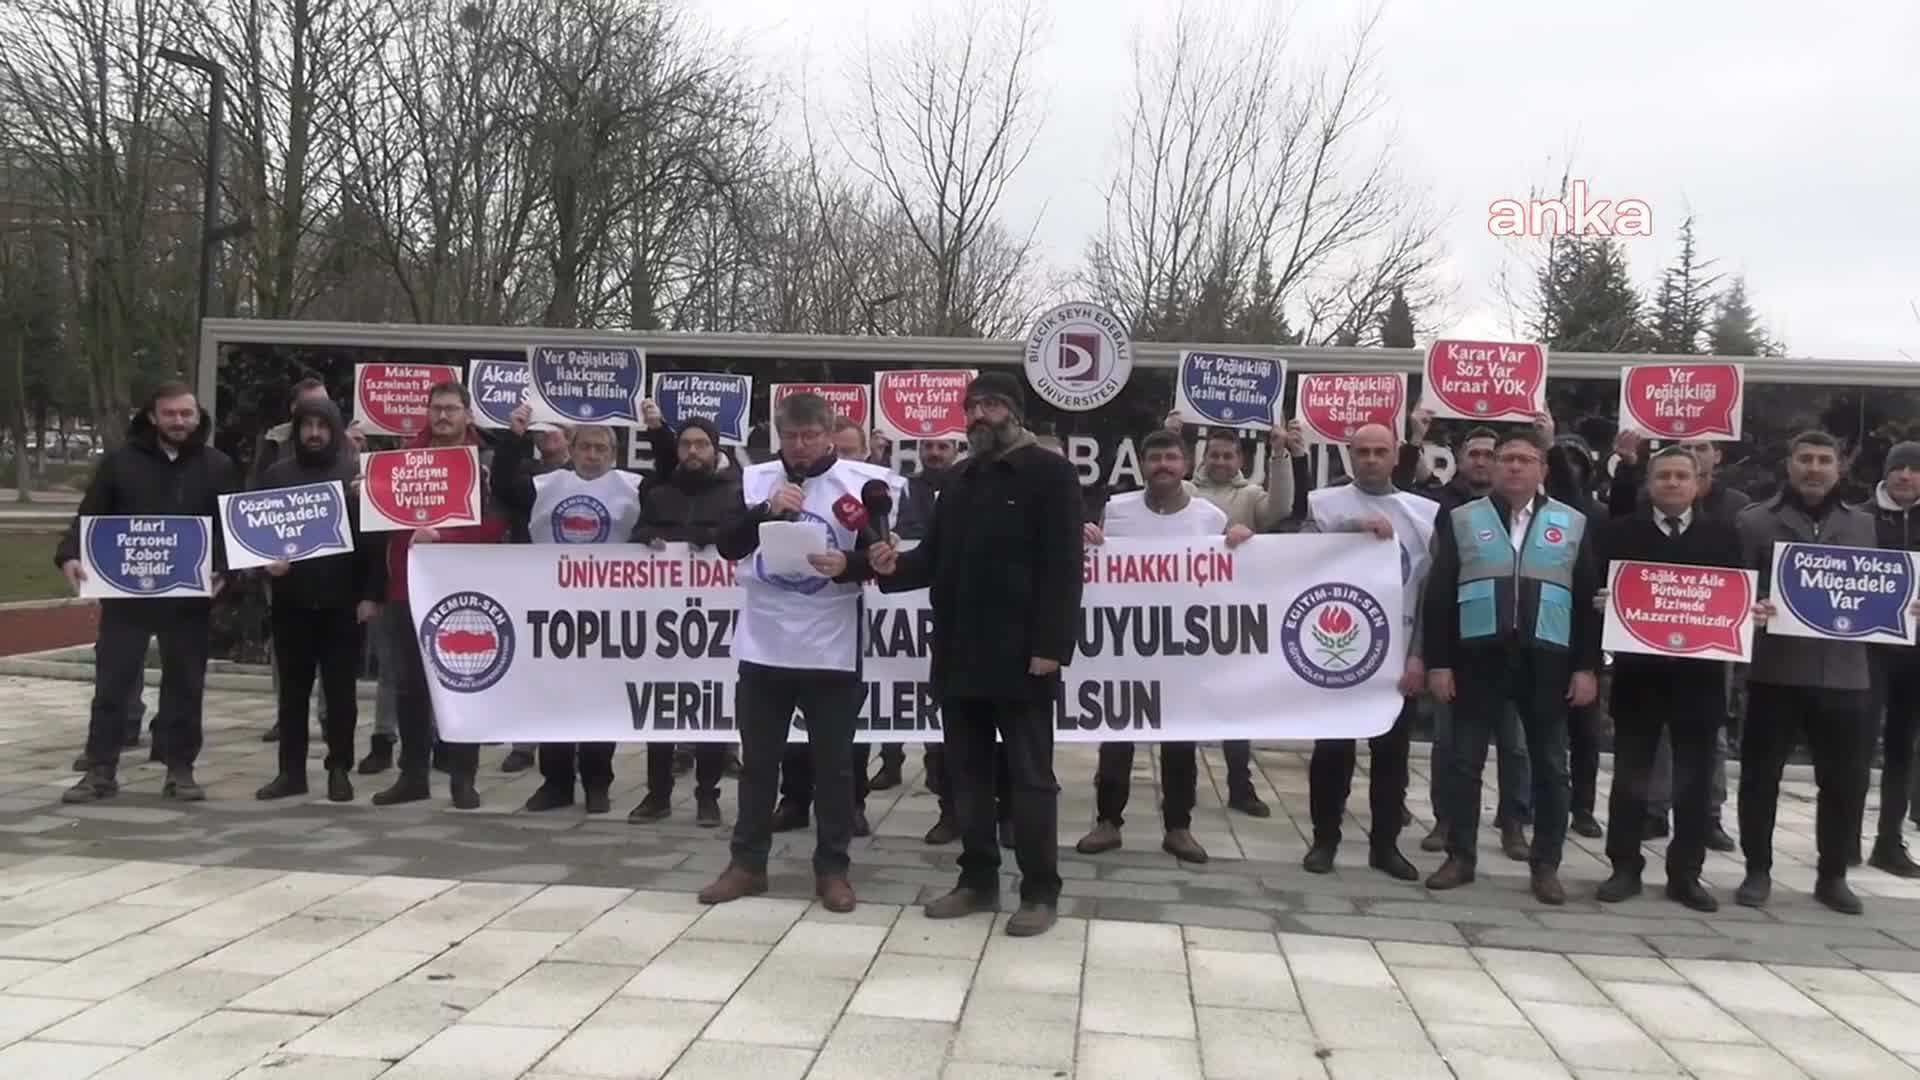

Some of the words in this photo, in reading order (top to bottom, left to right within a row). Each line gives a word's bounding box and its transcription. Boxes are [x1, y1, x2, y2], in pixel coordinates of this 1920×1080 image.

[1028, 317, 1057, 363] BİLECİK
[1057, 307, 1092, 322] ŞEYH
[542, 349, 565, 365] Yer
[1447, 343, 1496, 361] Karar
[1498, 346, 1526, 363] Var
[1193, 355, 1214, 370] Yer
[1456, 360, 1484, 377] Söz
[1487, 362, 1517, 378] Var
[385, 366, 430, 378] Makam
[481, 364, 530, 384] Akade
[920, 373, 966, 388] Personel
[1667, 367, 1695, 384] Yer
[544, 380, 584, 397] Teslim
[690, 376, 741, 393] Personel
[1037, 378, 1119, 407] ÜNİVERSİTESİ
[1191, 385, 1226, 401] Teslim
[1310, 377, 1332, 392] Yer
[1492, 378, 1527, 396] YOK
[481, 384, 517, 404] Zam
[926, 388, 959, 403] Evlat
[1328, 406, 1372, 424] Sağlar
[1655, 400, 1706, 418] Haktır
[403, 451, 434, 467] Toplu
[391, 479, 449, 494] Kararına
[238, 499, 286, 515] Çözüm
[286, 491, 331, 507] Yoksa
[394, 492, 446, 509] Uyulsun
[246, 503, 329, 528] Mücadele
[274, 523, 305, 539] Var
[116, 533, 178, 547] Personel
[124, 547, 170, 561] Robot
[120, 560, 175, 577] Değildir
[557, 553, 682, 588] ÜNİVERSİTE
[1106, 553, 1179, 584] HAKKI
[1186, 547, 1234, 587] İÇİN
[1794, 551, 1848, 571] Çözüm
[1851, 555, 1904, 575] Yoksa
[1681, 574, 1697, 586] ve
[1699, 572, 1726, 587] Aile
[1800, 568, 1897, 594] Mücadele
[1654, 597, 1705, 612] Bizimde
[1828, 589, 1865, 611] Var
[429, 594, 507, 626] MEMUR-SEN
[1625, 606, 1735, 629] Mazeretimizdir
[526, 608, 647, 660] TOPLU
[1076, 603, 1269, 658] UYULSUN
